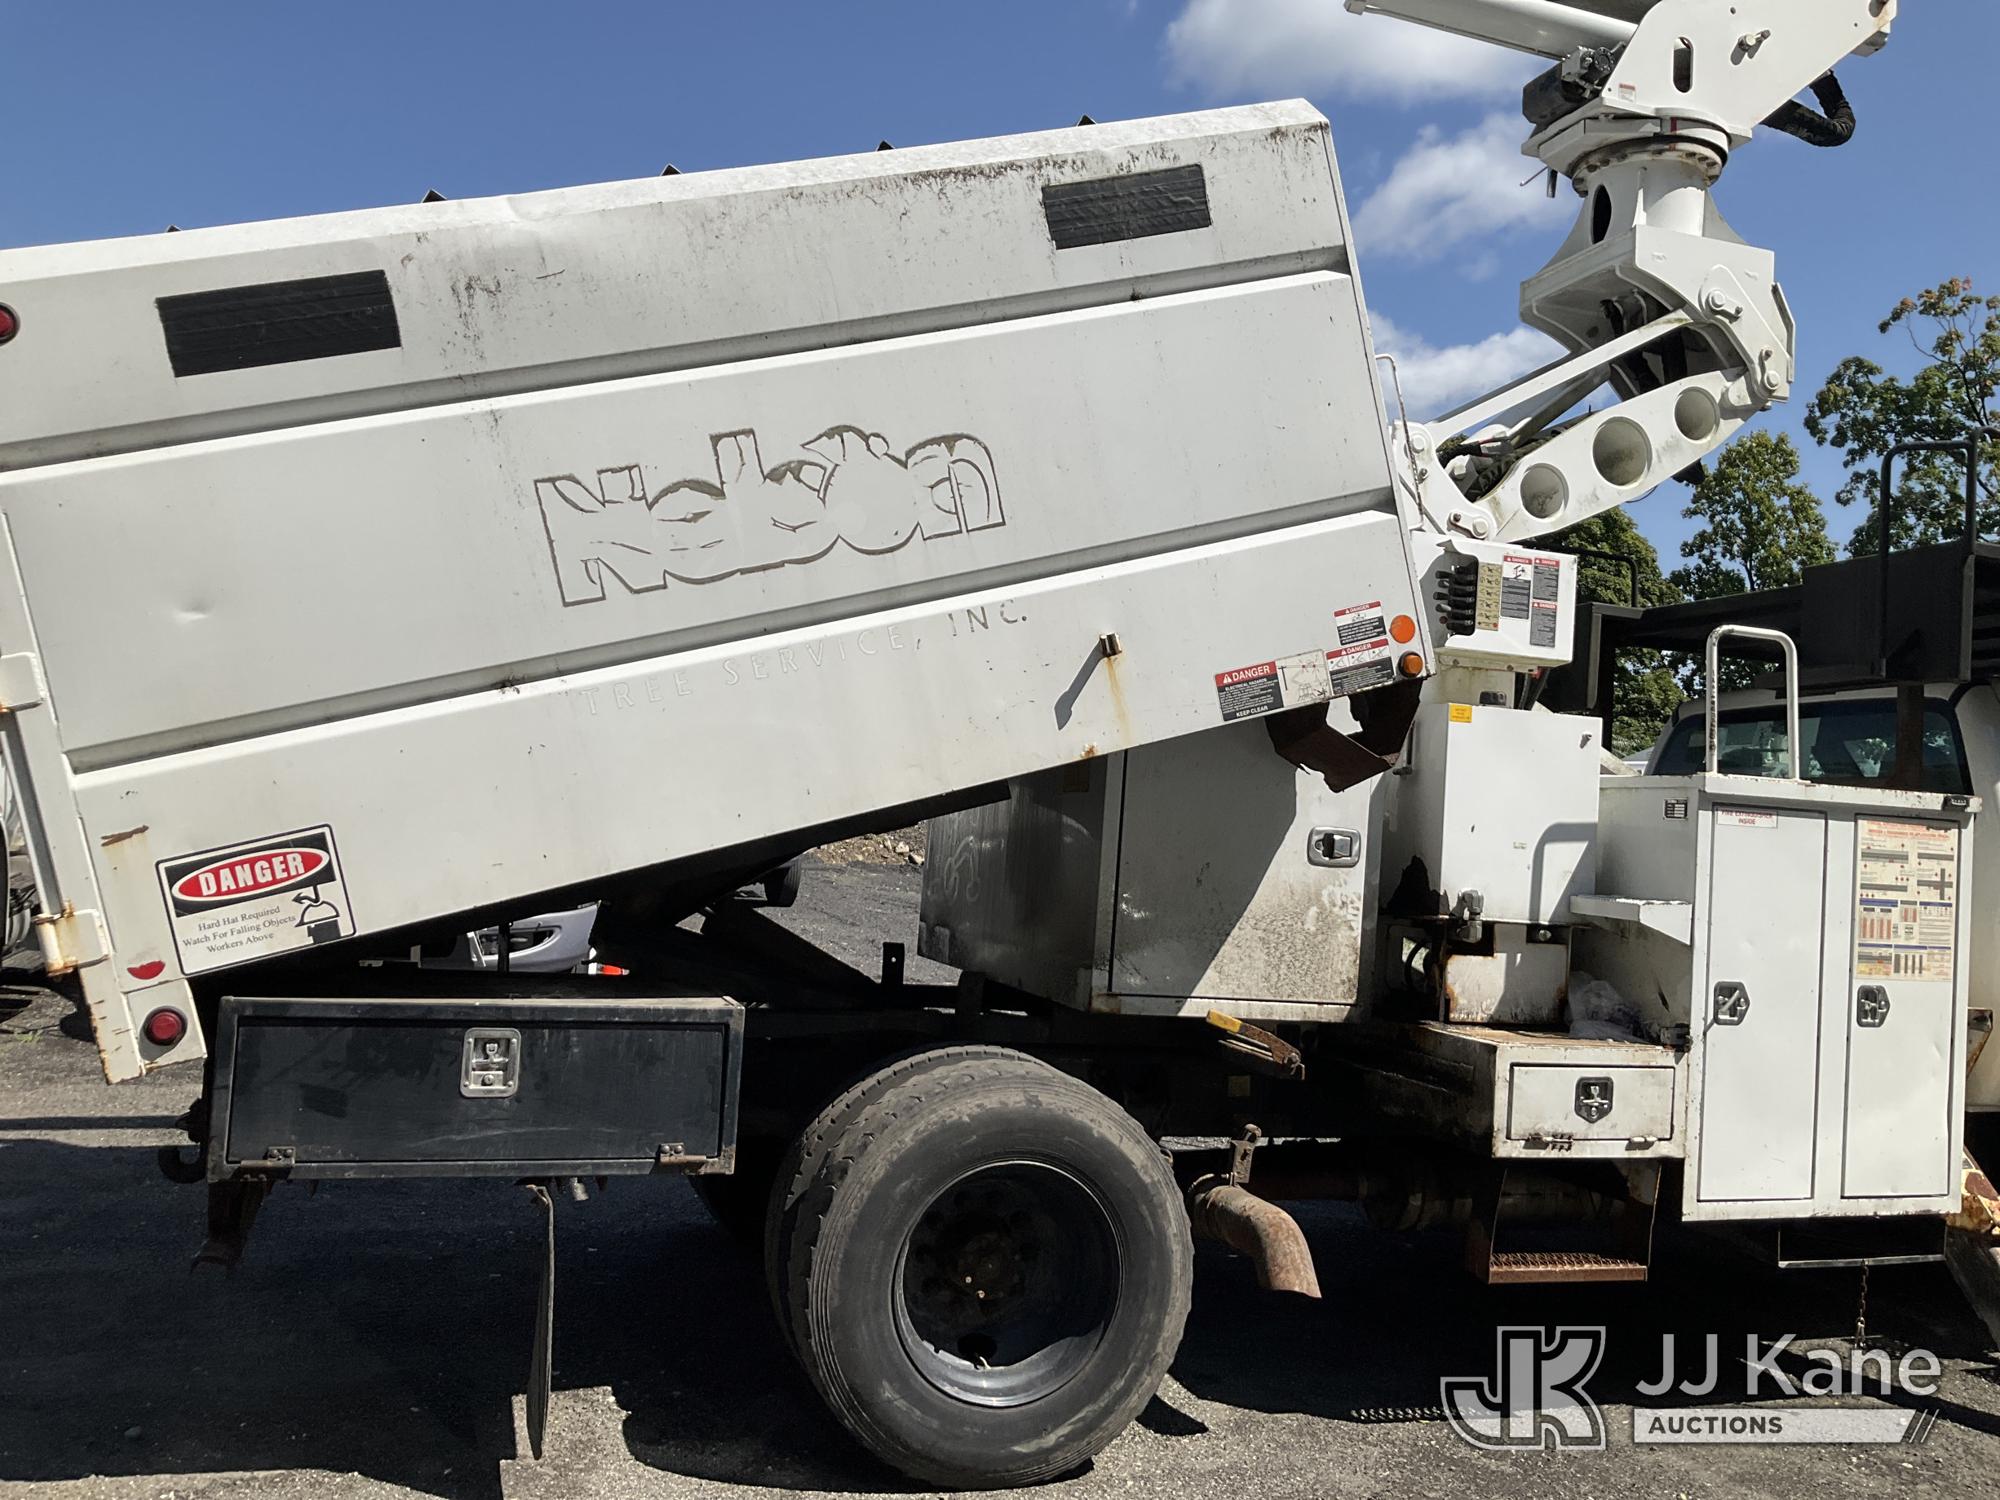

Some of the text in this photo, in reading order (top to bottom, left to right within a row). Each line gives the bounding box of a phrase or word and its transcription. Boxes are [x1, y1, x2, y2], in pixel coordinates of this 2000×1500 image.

[579, 599, 1028, 716] TREE SERVICE, INC.
[1347, 643, 1372, 654] DANGER
[1232, 665, 1270, 682] DANGER
[1236, 705, 1269, 718] KEEP CLEAR
[199, 852, 305, 896] DANGER
[198, 905, 280, 931] Hard Hat Required
[183, 915, 297, 947] Watch For Falling Objects
[206, 932, 274, 953] Workers Above
